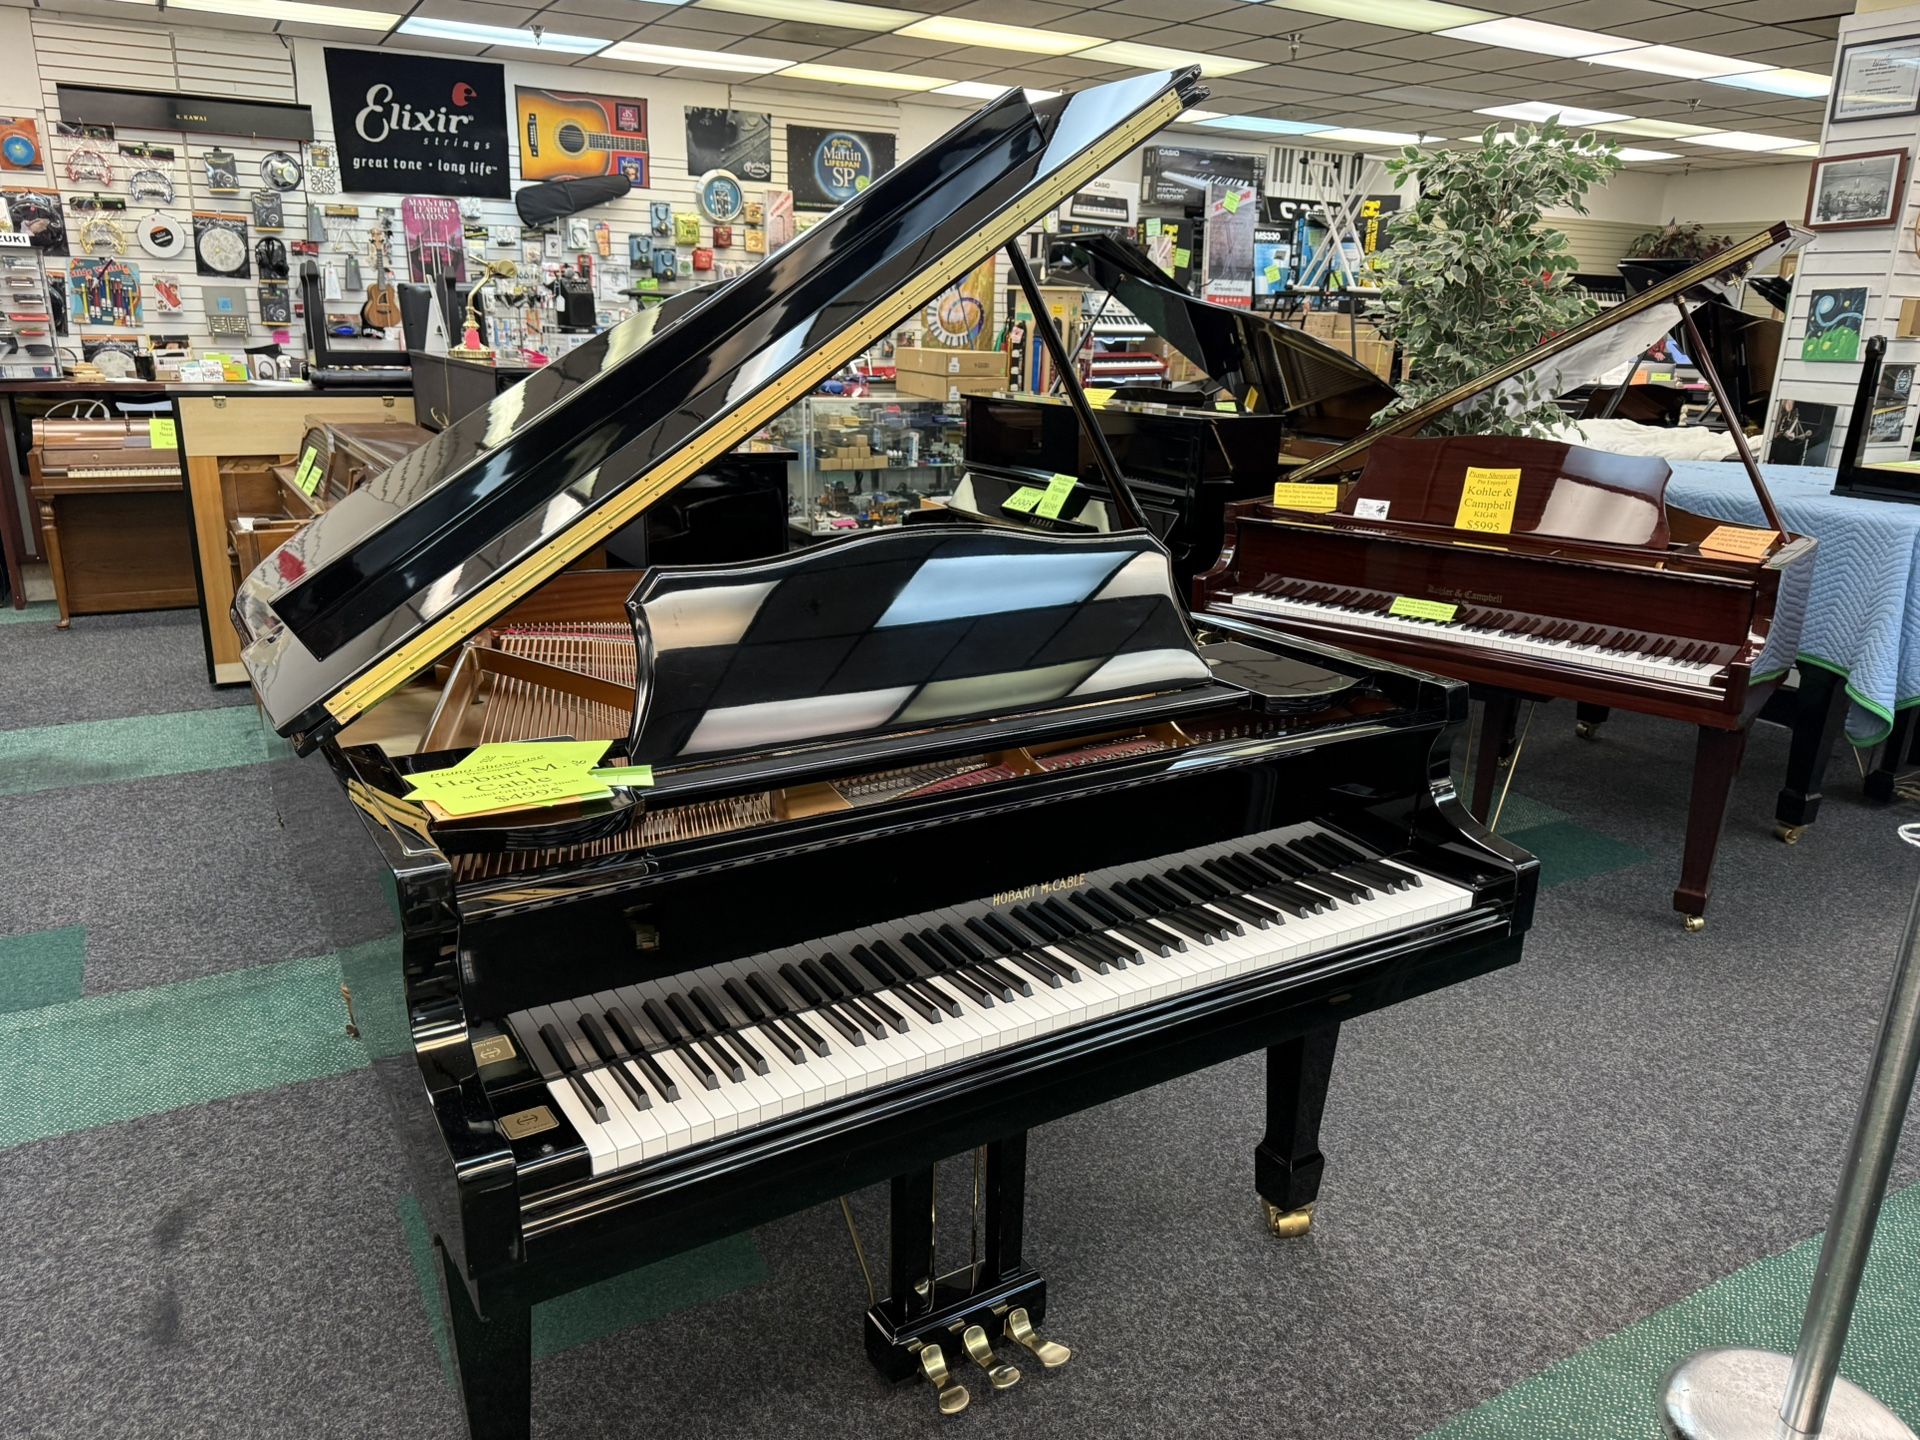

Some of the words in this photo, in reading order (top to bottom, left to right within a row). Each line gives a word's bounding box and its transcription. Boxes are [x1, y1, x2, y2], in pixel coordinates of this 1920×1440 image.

[355, 83, 470, 143] Elixir
[423, 137, 490, 150] strings
[824, 146, 861, 161] Martin
[1159, 148, 1180, 156] CASIO
[353, 157, 389, 170] great
[393, 158, 422, 170] tone
[438, 159, 466, 175] long
[824, 160, 861, 168] LIFESPAN
[832, 167, 856, 187] SP
[1094, 181, 1110, 189] CASIO
[409, 198, 452, 207] MAESTRO
[413, 206, 448, 214] LEADER
[1254, 231, 1280, 241] MS330
[1469, 471, 1487, 479] Piano
[1467, 486, 1502, 497] Kohler
[1504, 488, 1512, 497] &
[1464, 498, 1511, 511] Campbell
[1467, 520, 1500, 531] $5995
[1455, 589, 1463, 597] &
[1465, 590, 1502, 603] Campbell
[477, 755, 544, 771] Showcase
[432, 770, 527, 788] Hobart
[531, 763, 568, 773] M.
[475, 776, 553, 792] Cable
[494, 787, 564, 803] $4995
[993, 884, 1038, 907] HOBART
